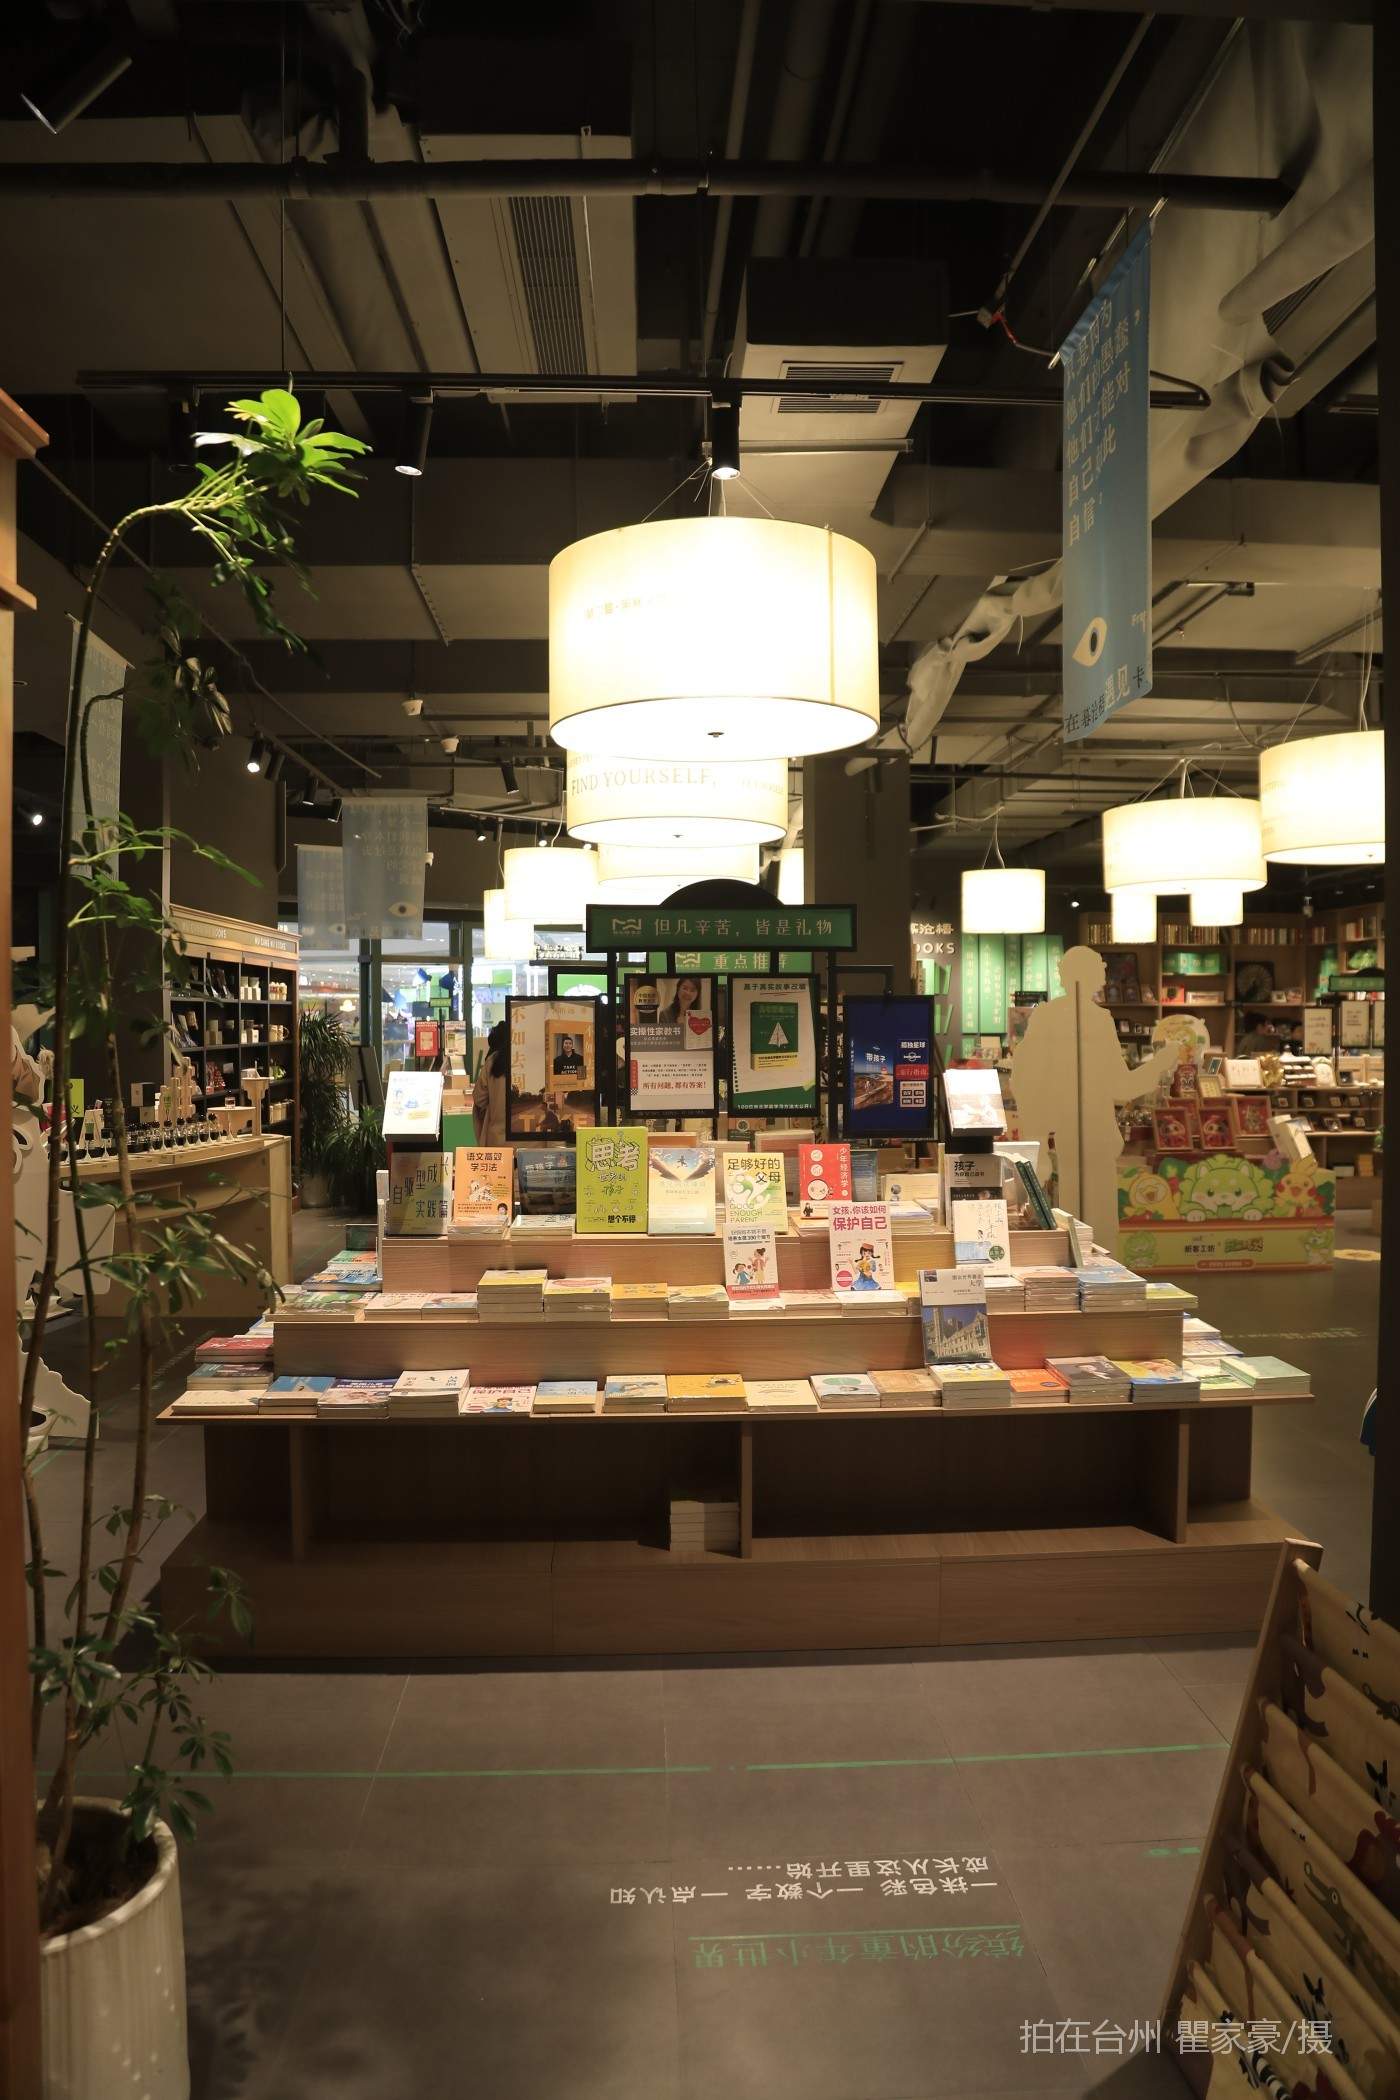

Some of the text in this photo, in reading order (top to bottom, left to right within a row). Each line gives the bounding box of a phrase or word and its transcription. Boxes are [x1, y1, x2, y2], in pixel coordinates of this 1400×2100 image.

[571, 773, 599, 797] FIND
[654, 917, 832, 936] 但凡辛苦，皆是礼物
[466, 1152, 503, 1161] 语文高效
[470, 1163, 498, 1172] 学习法
[727, 1157, 781, 1171] 足够好的
[954, 1161, 976, 1172] 孩子
[755, 1171, 781, 1184] 父母
[415, 1199, 448, 1218] 实践篇
[833, 1216, 888, 1231] 保护自己
[609, 1876, 998, 1905] 一抹色彩 一个数字 一点认知
